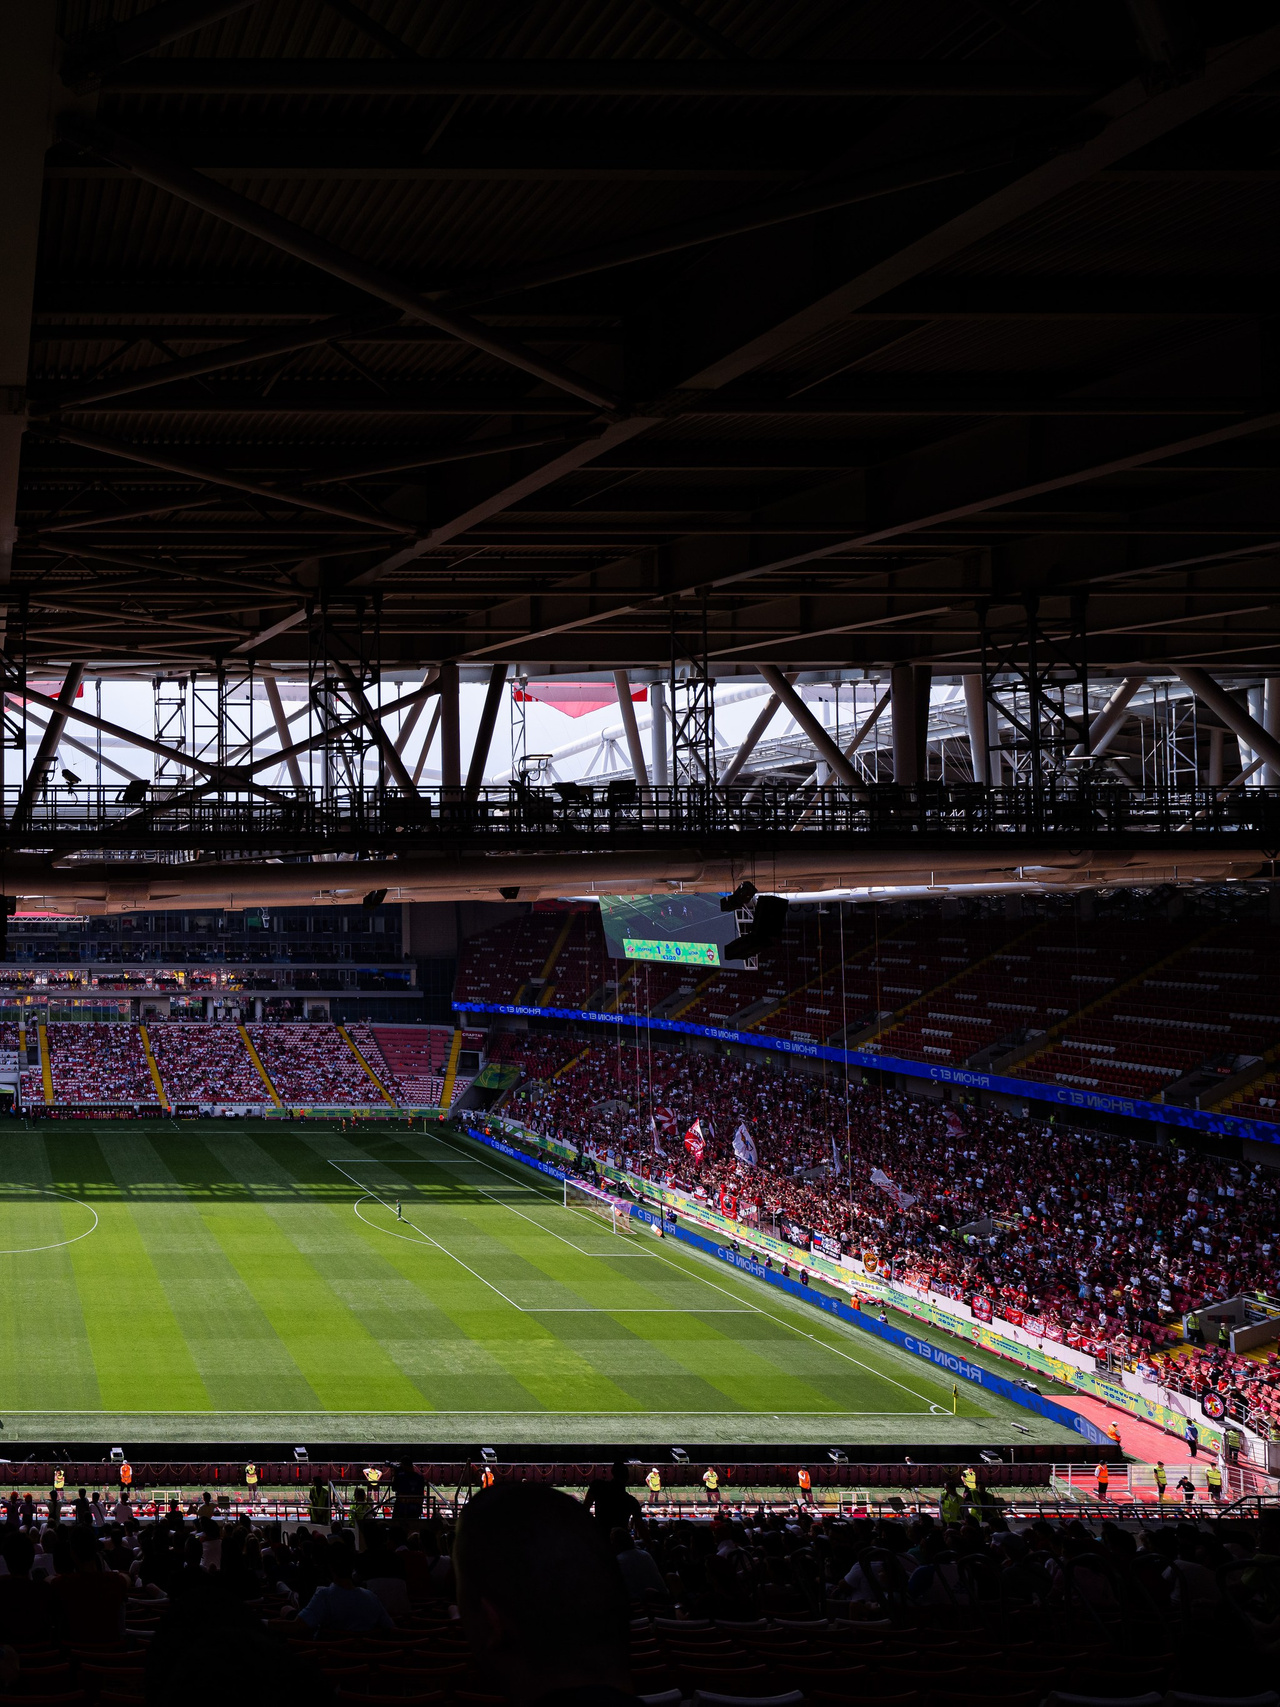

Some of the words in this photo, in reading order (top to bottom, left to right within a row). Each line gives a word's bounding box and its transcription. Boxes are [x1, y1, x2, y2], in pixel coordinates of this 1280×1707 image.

[656, 946, 661, 954] 1
[675, 948, 681, 956] 0
[499, 1005, 505, 1013] С
[506, 1006, 515, 1014] 13
[516, 1006, 541, 1016] ИЮНЯ
[581, 1012, 587, 1020] С
[588, 1012, 597, 1021] 13
[598, 1013, 624, 1023] ИЮНЯ
[704, 1027, 710, 1036] С
[711, 1028, 718, 1038] 13
[719, 1030, 740, 1041] ИЮНЯ
[775, 1040, 782, 1049] С
[783, 1041, 792, 1051] 13
[793, 1042, 818, 1056] ИЮНЯ
[930, 1068, 938, 1078] С
[940, 1069, 952, 1080] 13
[952, 1071, 990, 1088] ИЮНЯ
[1057, 1090, 1066, 1101] С
[1069, 1091, 1084, 1104] 13
[1086, 1095, 1135, 1115] ИЮНЯ
[548, 1166, 566, 1180] ИЮНЯ
[717, 1248, 724, 1258] С
[726, 1251, 734, 1262] 13
[735, 1255, 766, 1279] ИЮНЯ
[904, 1336, 914, 1350] С
[917, 1342, 932, 1358] 13
[934, 1349, 982, 1384] ИЮНЯ
[1090, 1379, 1139, 1404] СУПЕРКУБОК
[1074, 1417, 1083, 1432] С
[1086, 1423, 1097, 1441] 13
